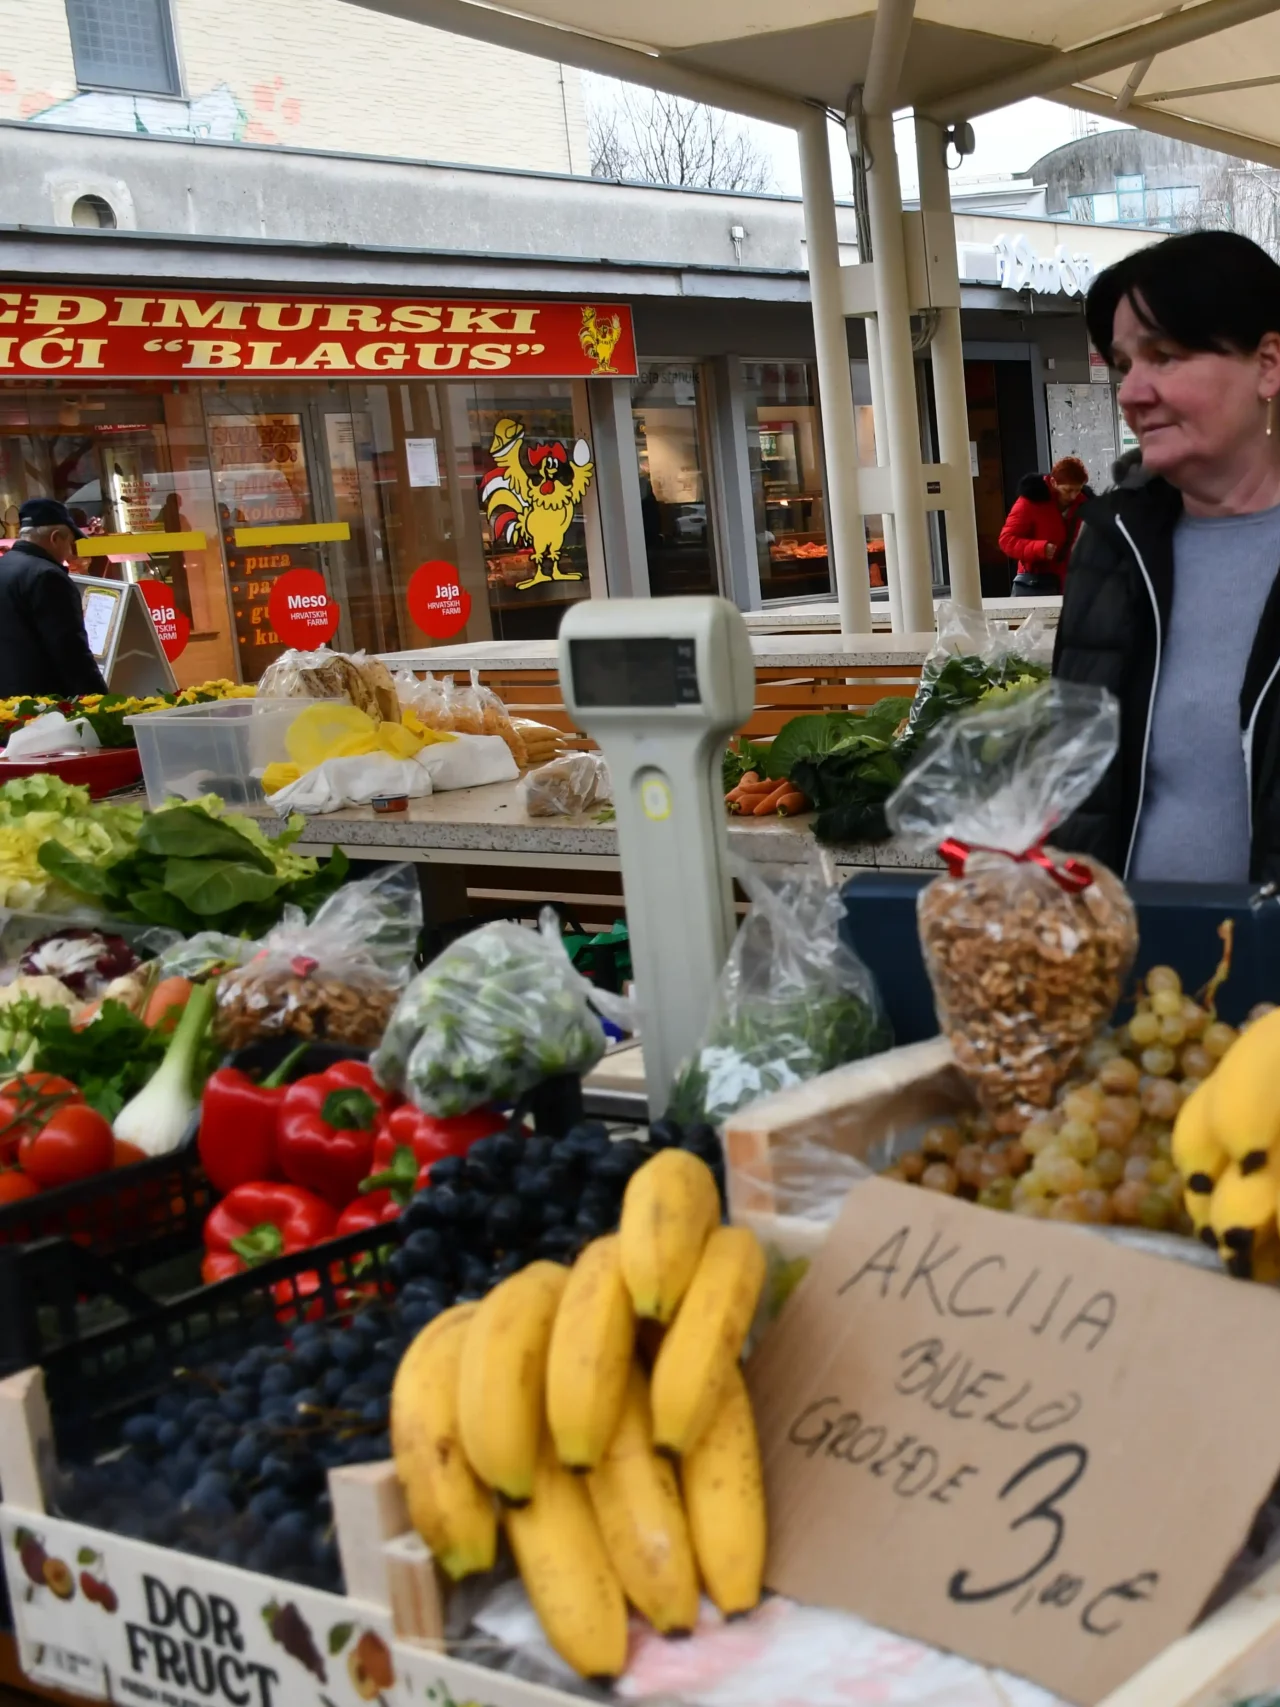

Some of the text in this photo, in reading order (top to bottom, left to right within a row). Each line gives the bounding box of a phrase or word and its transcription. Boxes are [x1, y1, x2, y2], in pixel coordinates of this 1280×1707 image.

[245, 554, 291, 575] pura
[435, 583, 460, 601] Jaja
[288, 594, 327, 609] Meso
[427, 600, 460, 610] HRVATSKIH
[290, 610, 328, 621] HRVATSKIH
[442, 607, 461, 616] FARMI
[307, 617, 328, 627] FARMI
[158, 631, 178, 641] ARMI
[836, 1225, 1117, 1352] AKCIJA
[142, 1574, 245, 1652] DOR
[124, 1621, 280, 1707] FRUCT
